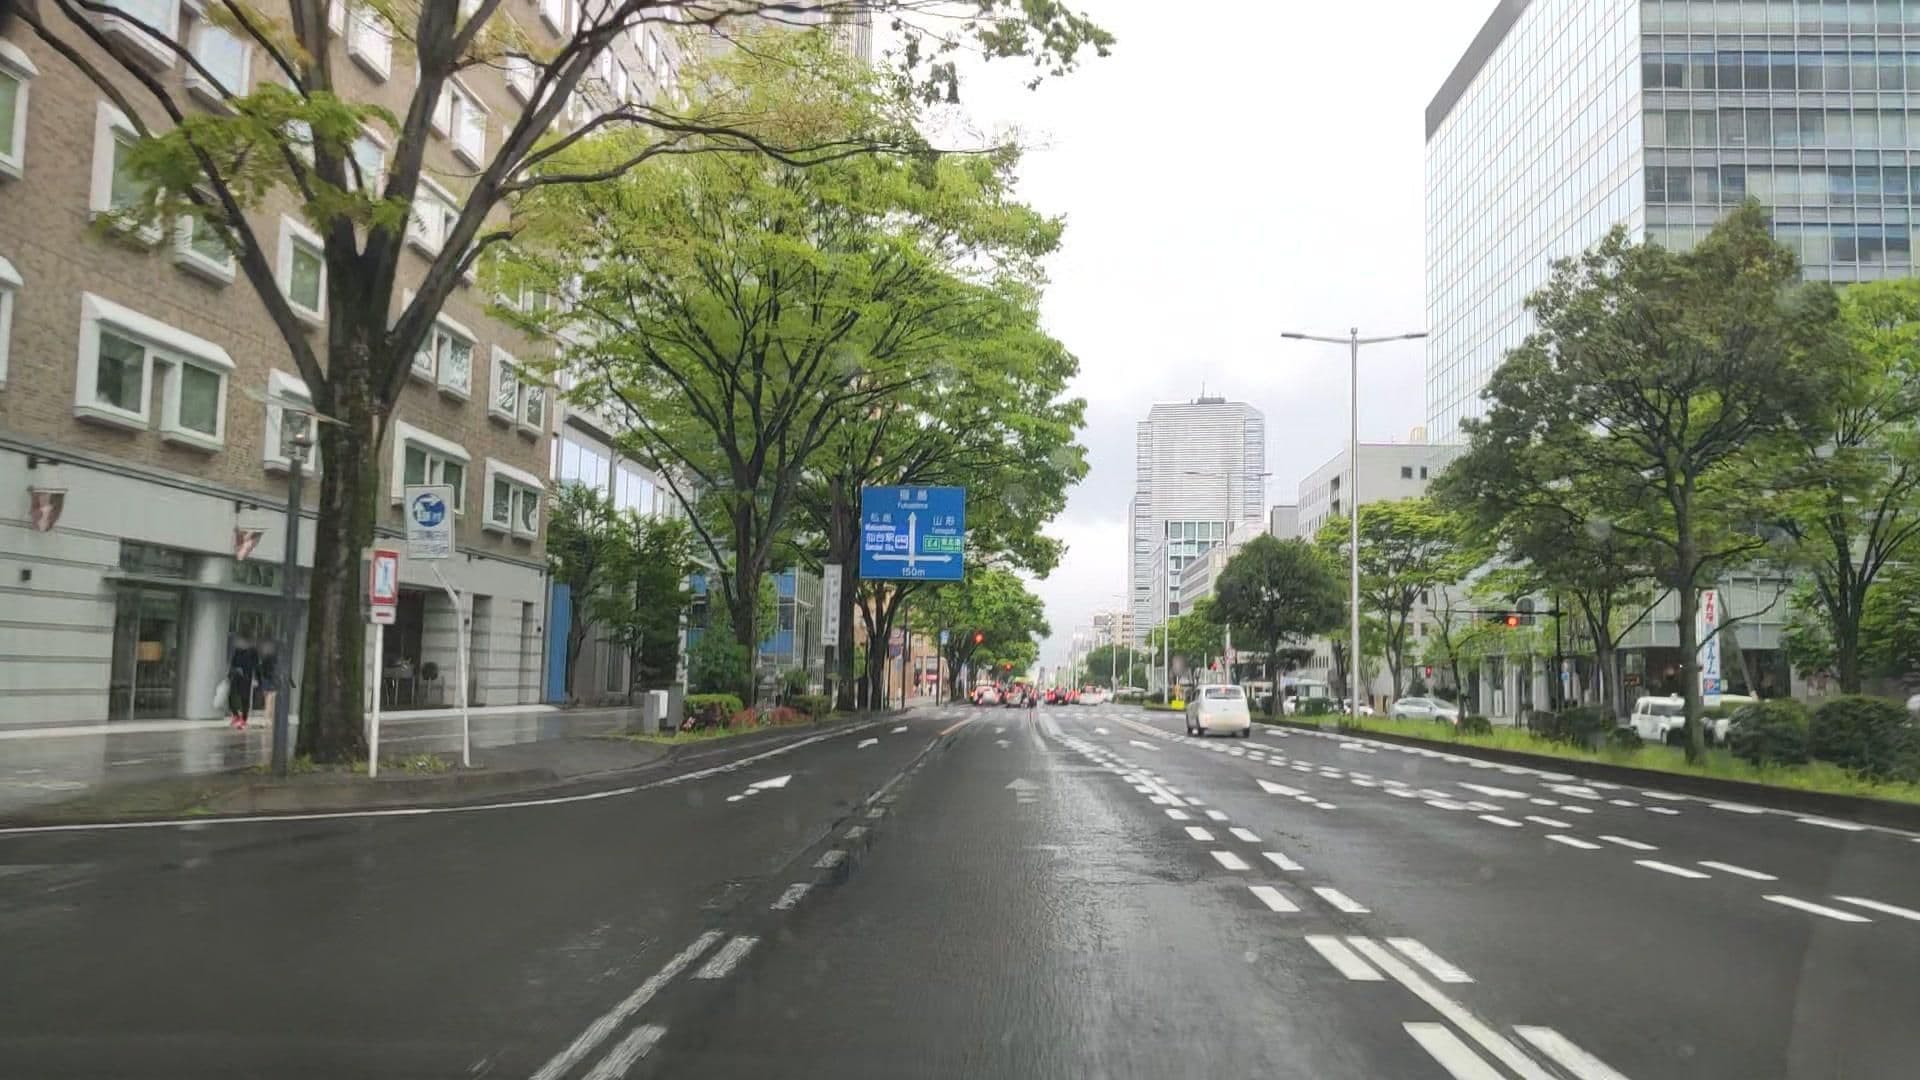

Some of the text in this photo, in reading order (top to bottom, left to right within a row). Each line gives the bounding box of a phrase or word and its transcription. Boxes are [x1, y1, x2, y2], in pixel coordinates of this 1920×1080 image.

[933, 515, 955, 526] 山形
[866, 532, 895, 543] 仙台駅
[902, 568, 925, 577] 150m
